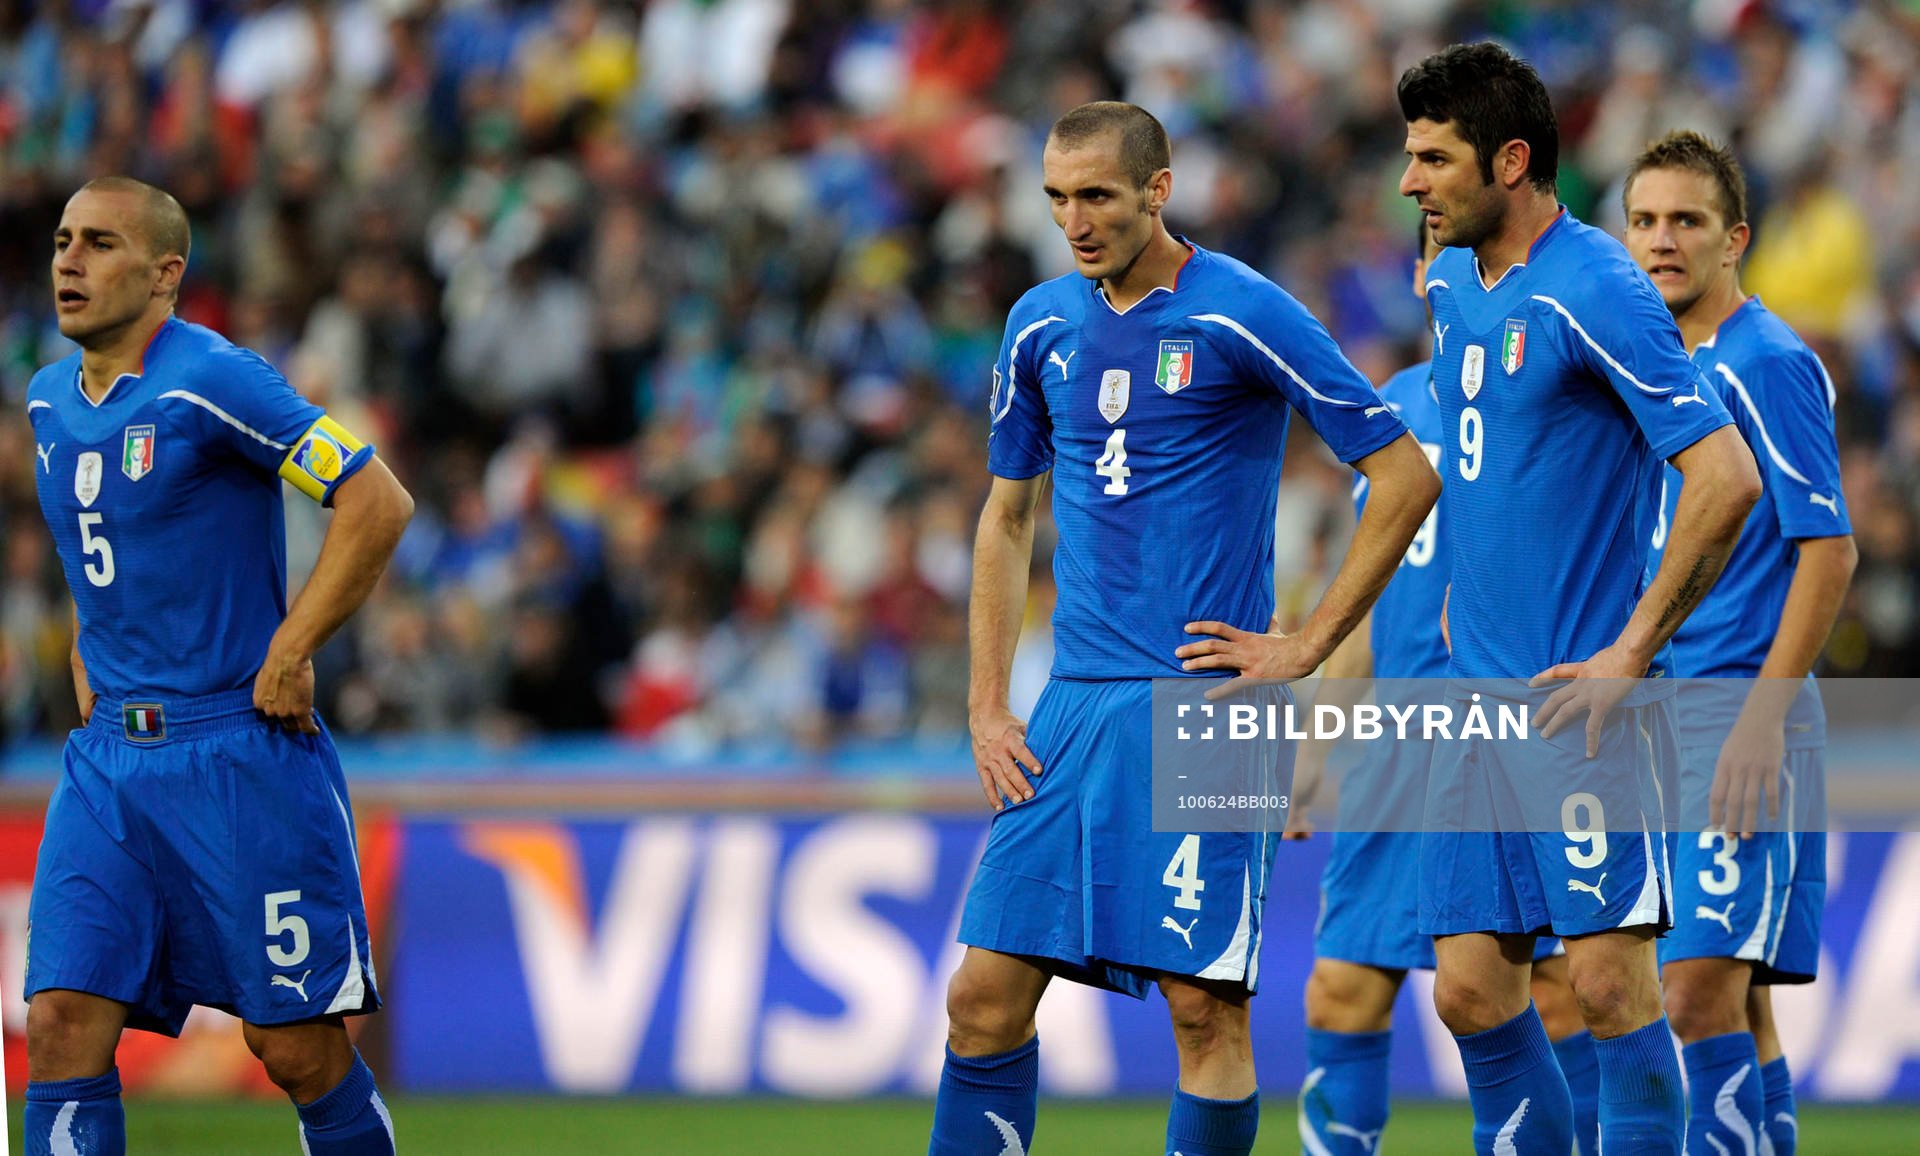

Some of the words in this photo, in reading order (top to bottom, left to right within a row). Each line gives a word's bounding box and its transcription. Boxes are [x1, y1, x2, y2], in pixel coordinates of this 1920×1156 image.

[1164, 344, 1189, 352] ITALIA
[1095, 429, 1132, 496] 4
[1459, 407, 1484, 482] 9
[78, 512, 116, 588] 5
[1561, 792, 1608, 869] 9
[1698, 826, 1741, 896] 3
[1163, 834, 1205, 911] 4
[264, 889, 310, 967] 5
